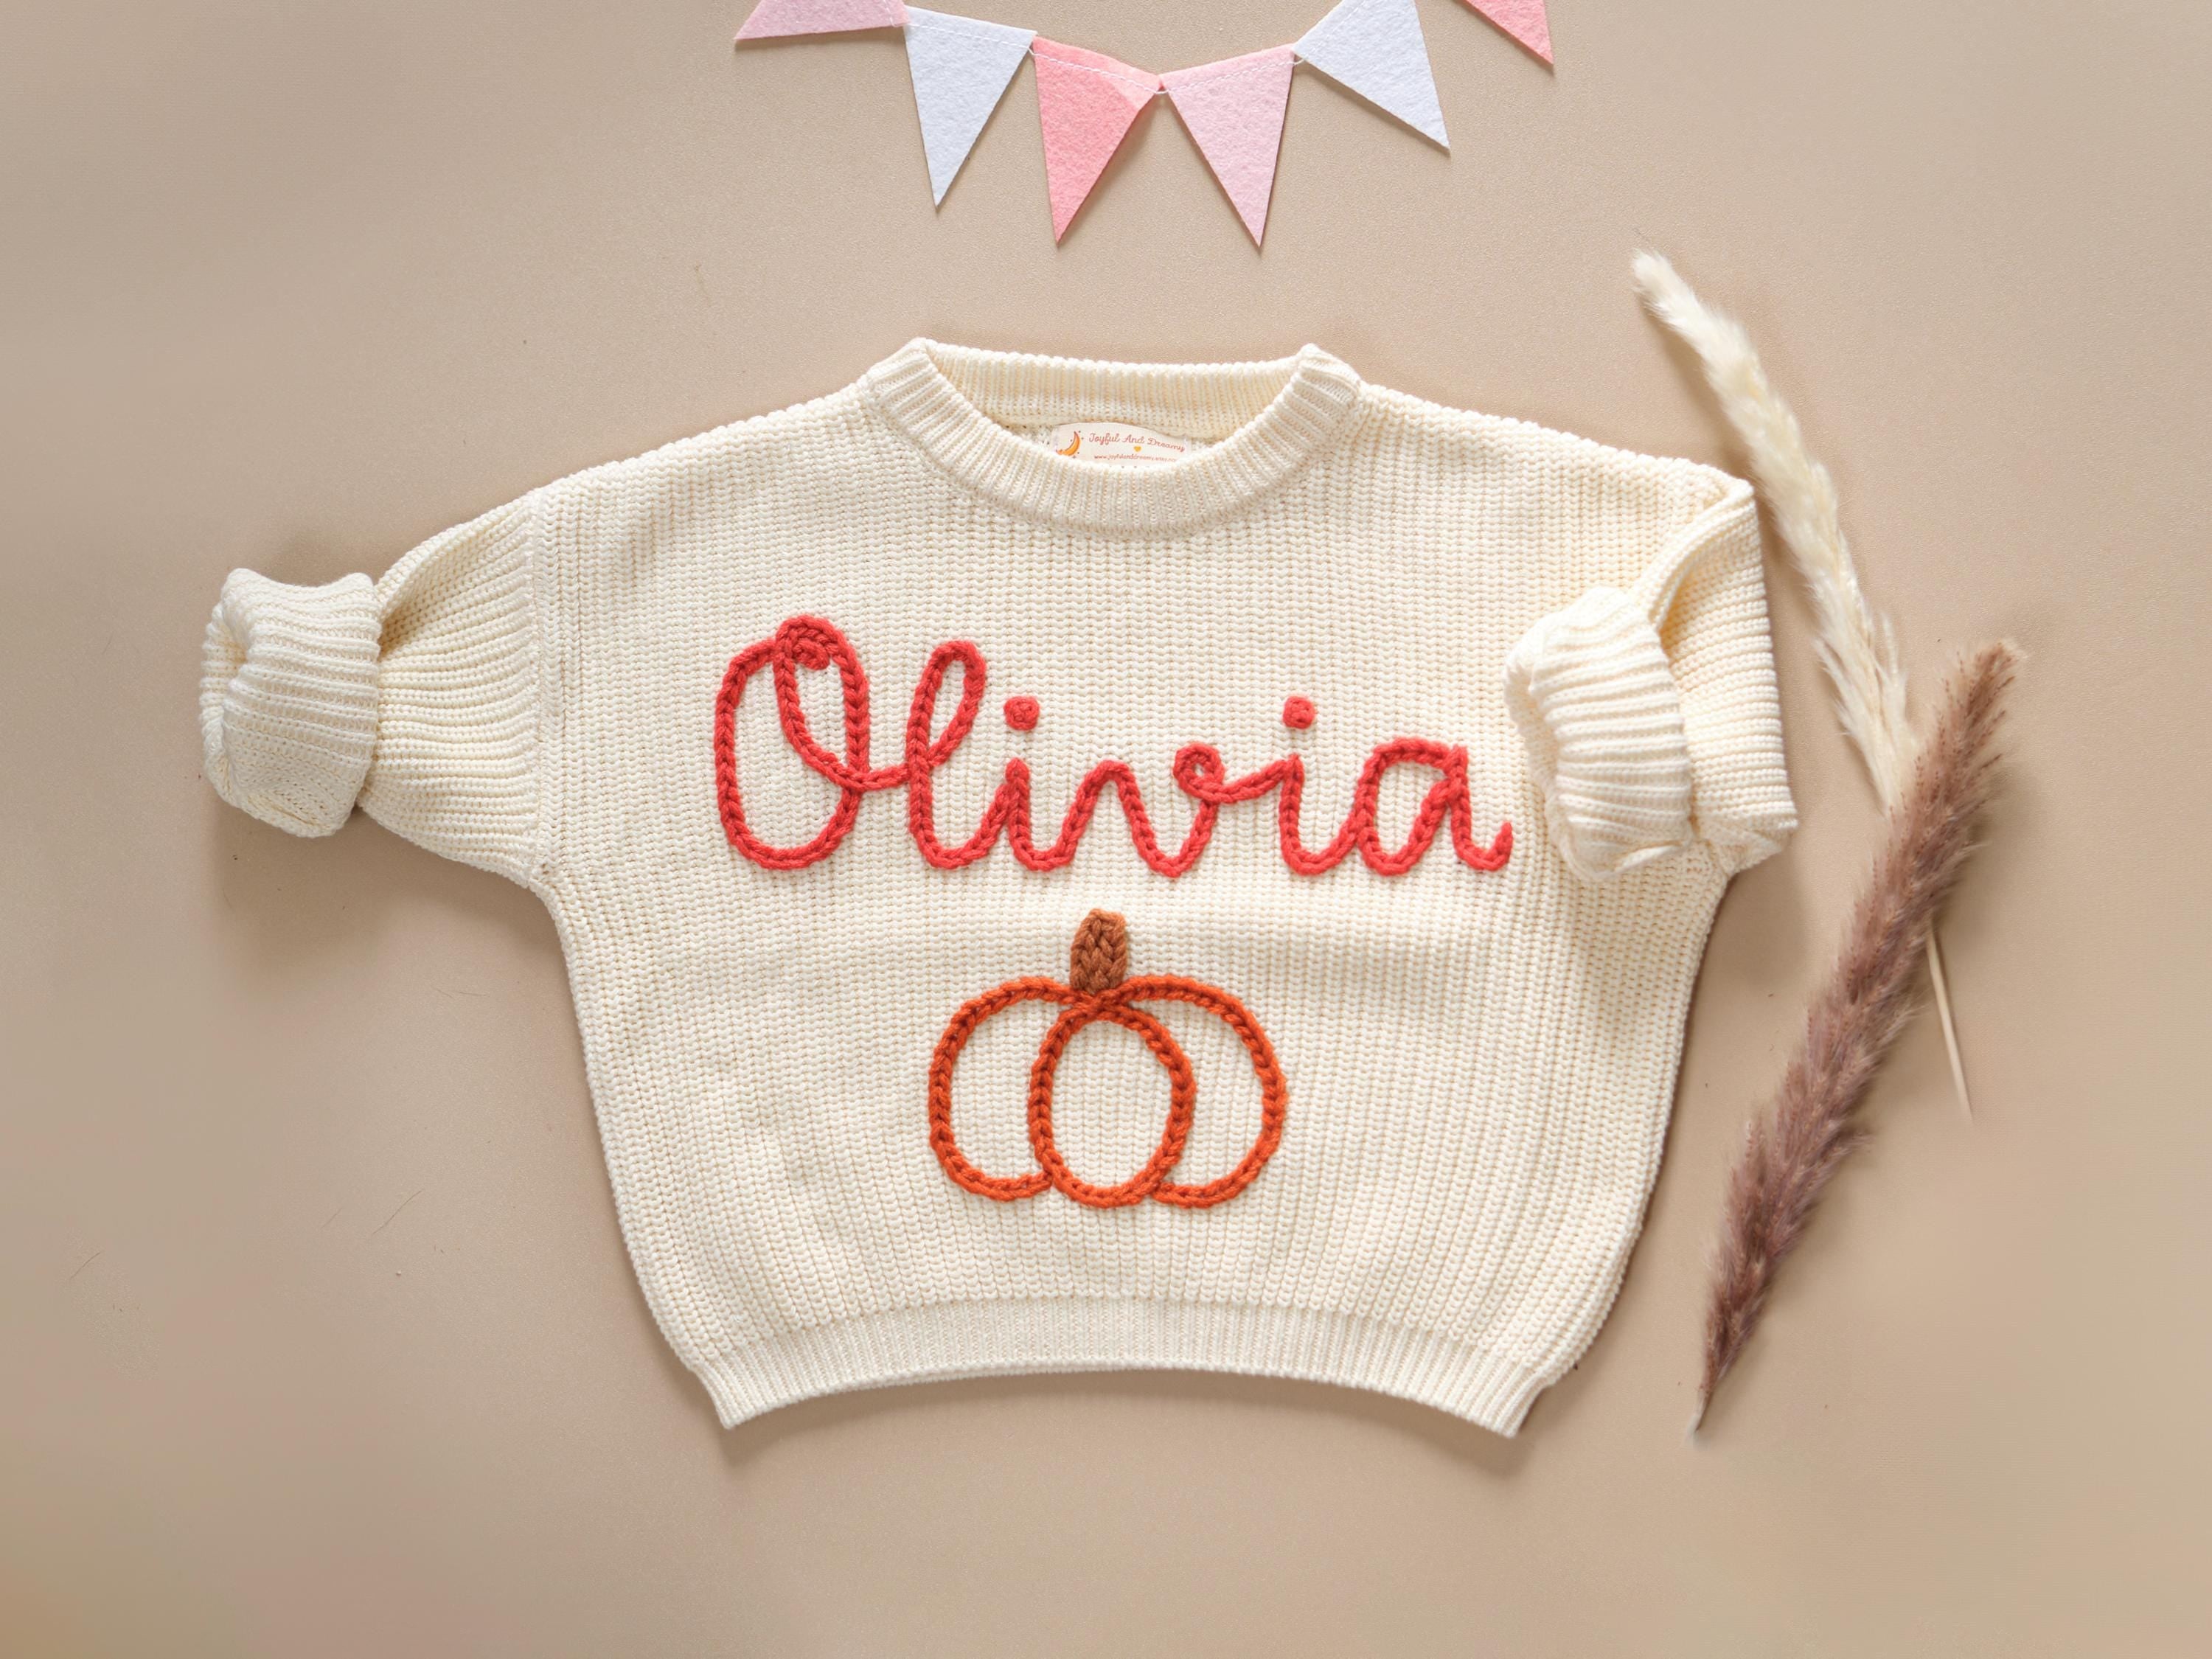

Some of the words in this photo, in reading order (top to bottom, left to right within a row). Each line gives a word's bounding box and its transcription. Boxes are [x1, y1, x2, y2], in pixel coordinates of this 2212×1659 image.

[1089, 433, 1119, 445] Joyful
[1122, 434, 1144, 444] And
[1147, 437, 1185, 452] Dreamy
[713, 614, 1513, 878] Olivia
